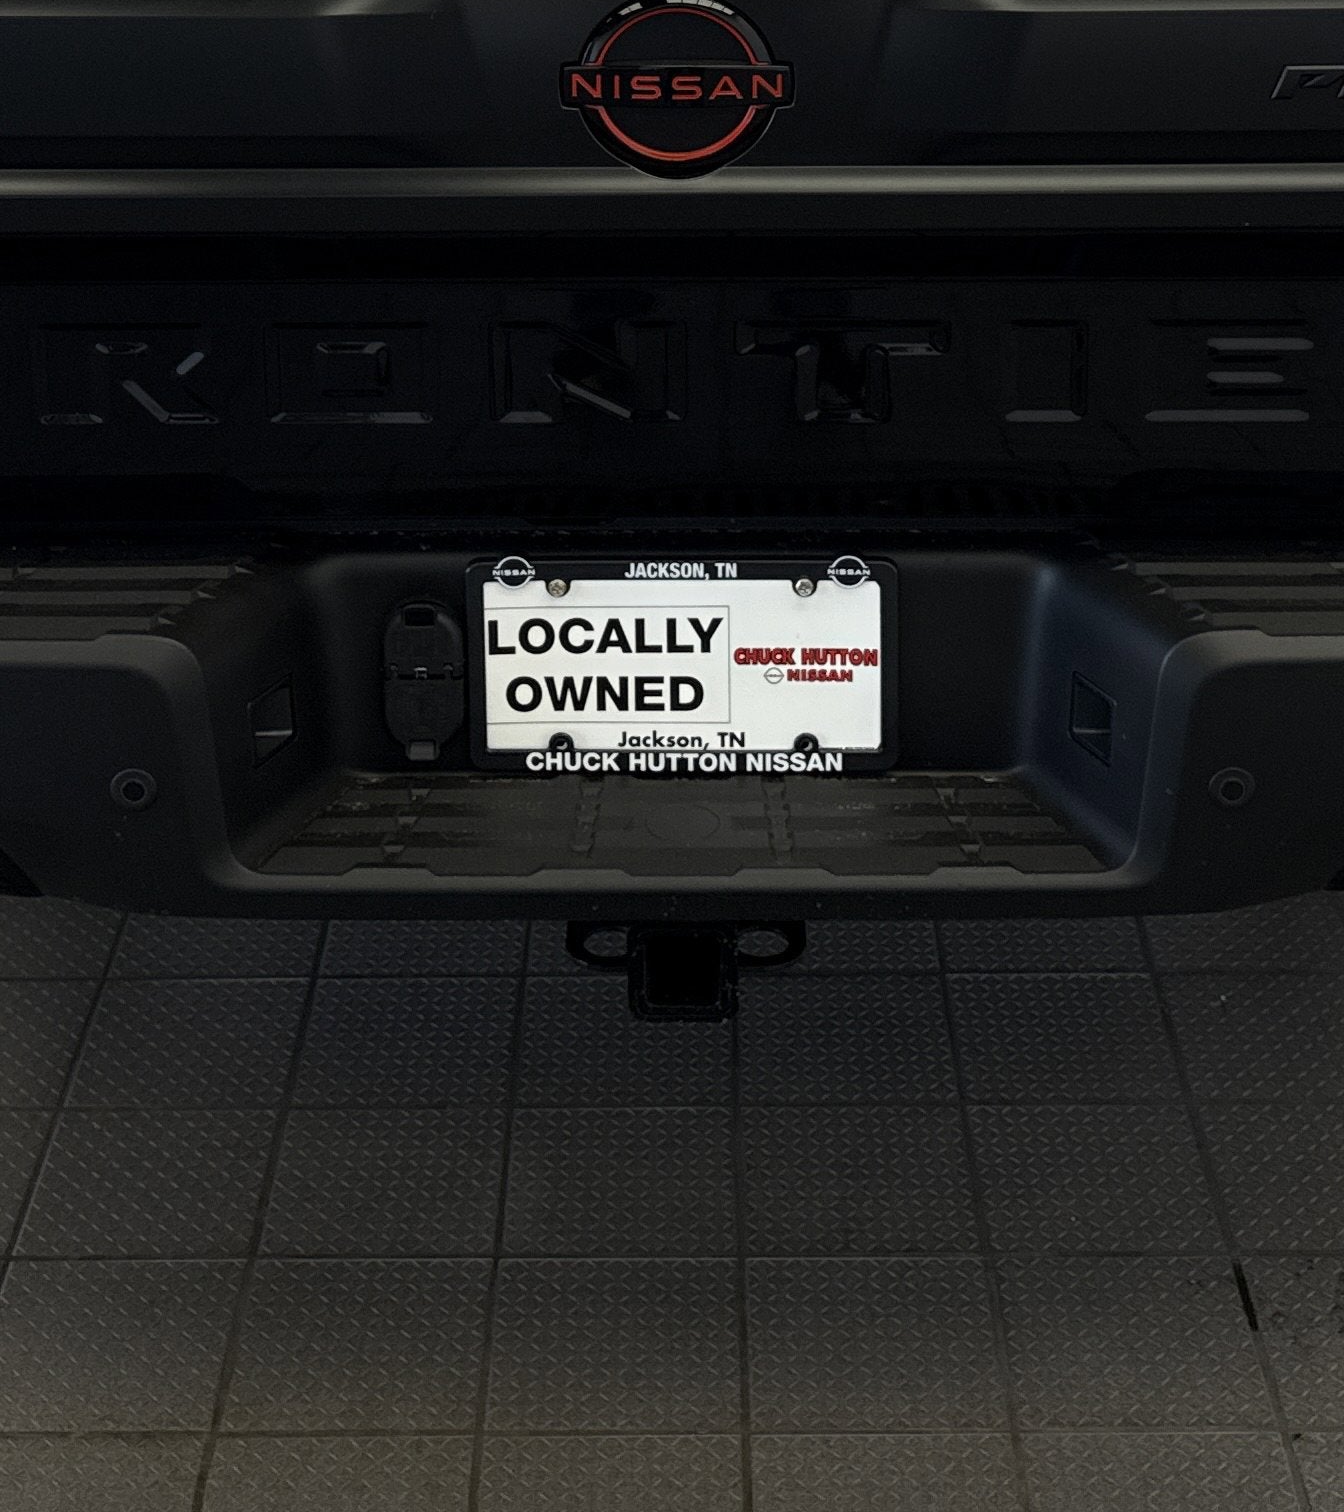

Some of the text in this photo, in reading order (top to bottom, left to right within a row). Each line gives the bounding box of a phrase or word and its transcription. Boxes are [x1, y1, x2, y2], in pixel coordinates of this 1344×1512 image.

[571, 73, 783, 100] NISSAN
[624, 562, 738, 580] JACKSON, TN
[487, 617, 724, 656] LOCALLY
[734, 647, 879, 666] CHUCK HUTTON
[787, 669, 854, 682] NISSAN
[505, 675, 705, 712] OWNED
[617, 731, 746, 750] Jackson, TN
[525, 750, 844, 773] CHUCK HUTTON NISSAN
